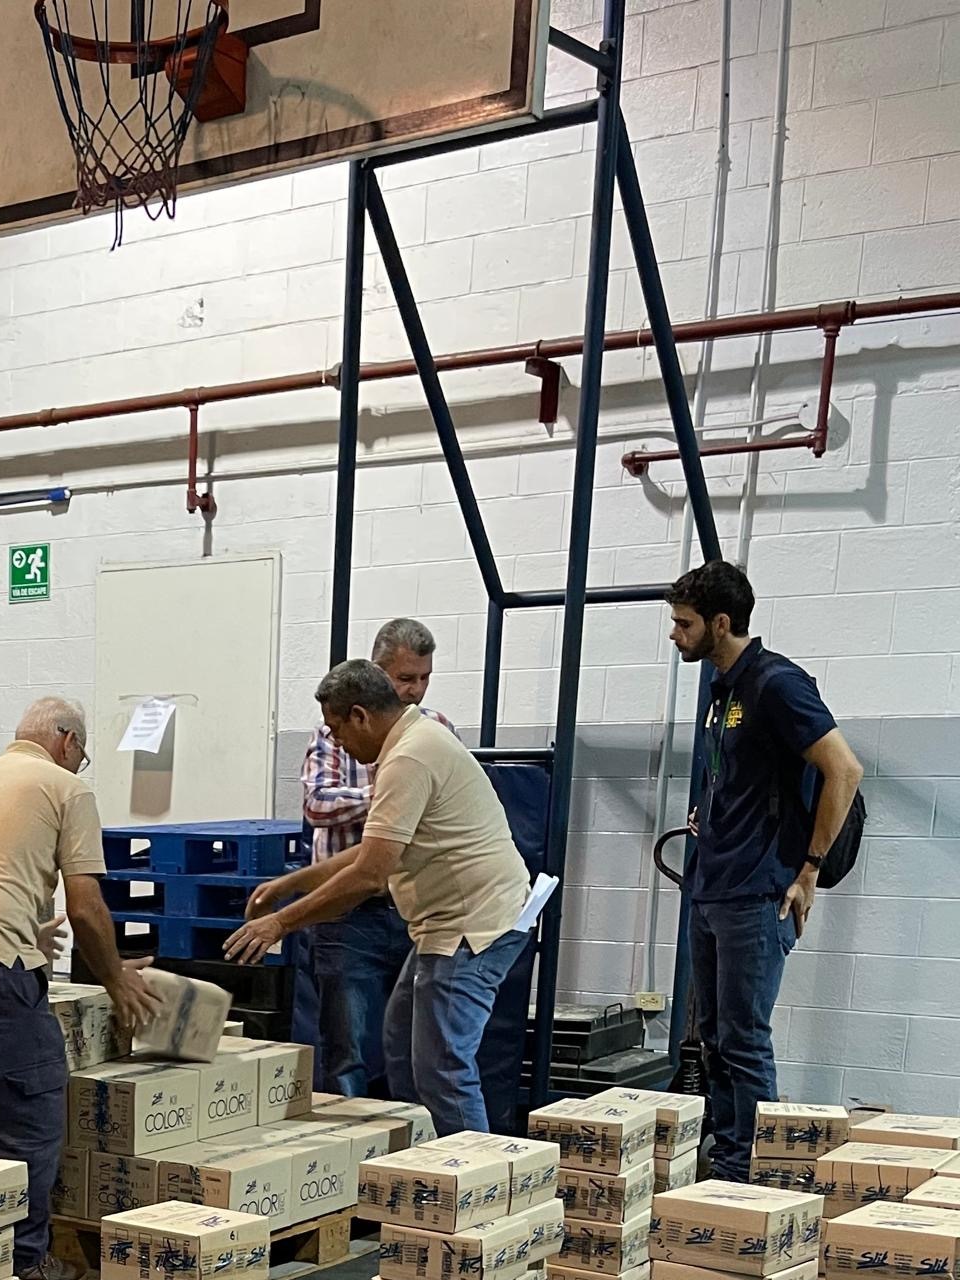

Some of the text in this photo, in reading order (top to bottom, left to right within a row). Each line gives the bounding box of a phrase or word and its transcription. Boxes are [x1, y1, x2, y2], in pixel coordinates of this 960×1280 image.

[268, 1079, 302, 1104] COLOR
[208, 1094, 246, 1119] COLOR
[145, 1107, 185, 1132] COLOR
[300, 1174, 337, 1201] COLOR
[862, 1186, 890, 1201] Slik
[686, 1228, 715, 1243] Slik
[738, 1238, 768, 1254] Slik
[856, 1251, 889, 1269] Slik
[916, 1257, 949, 1275] Slik
